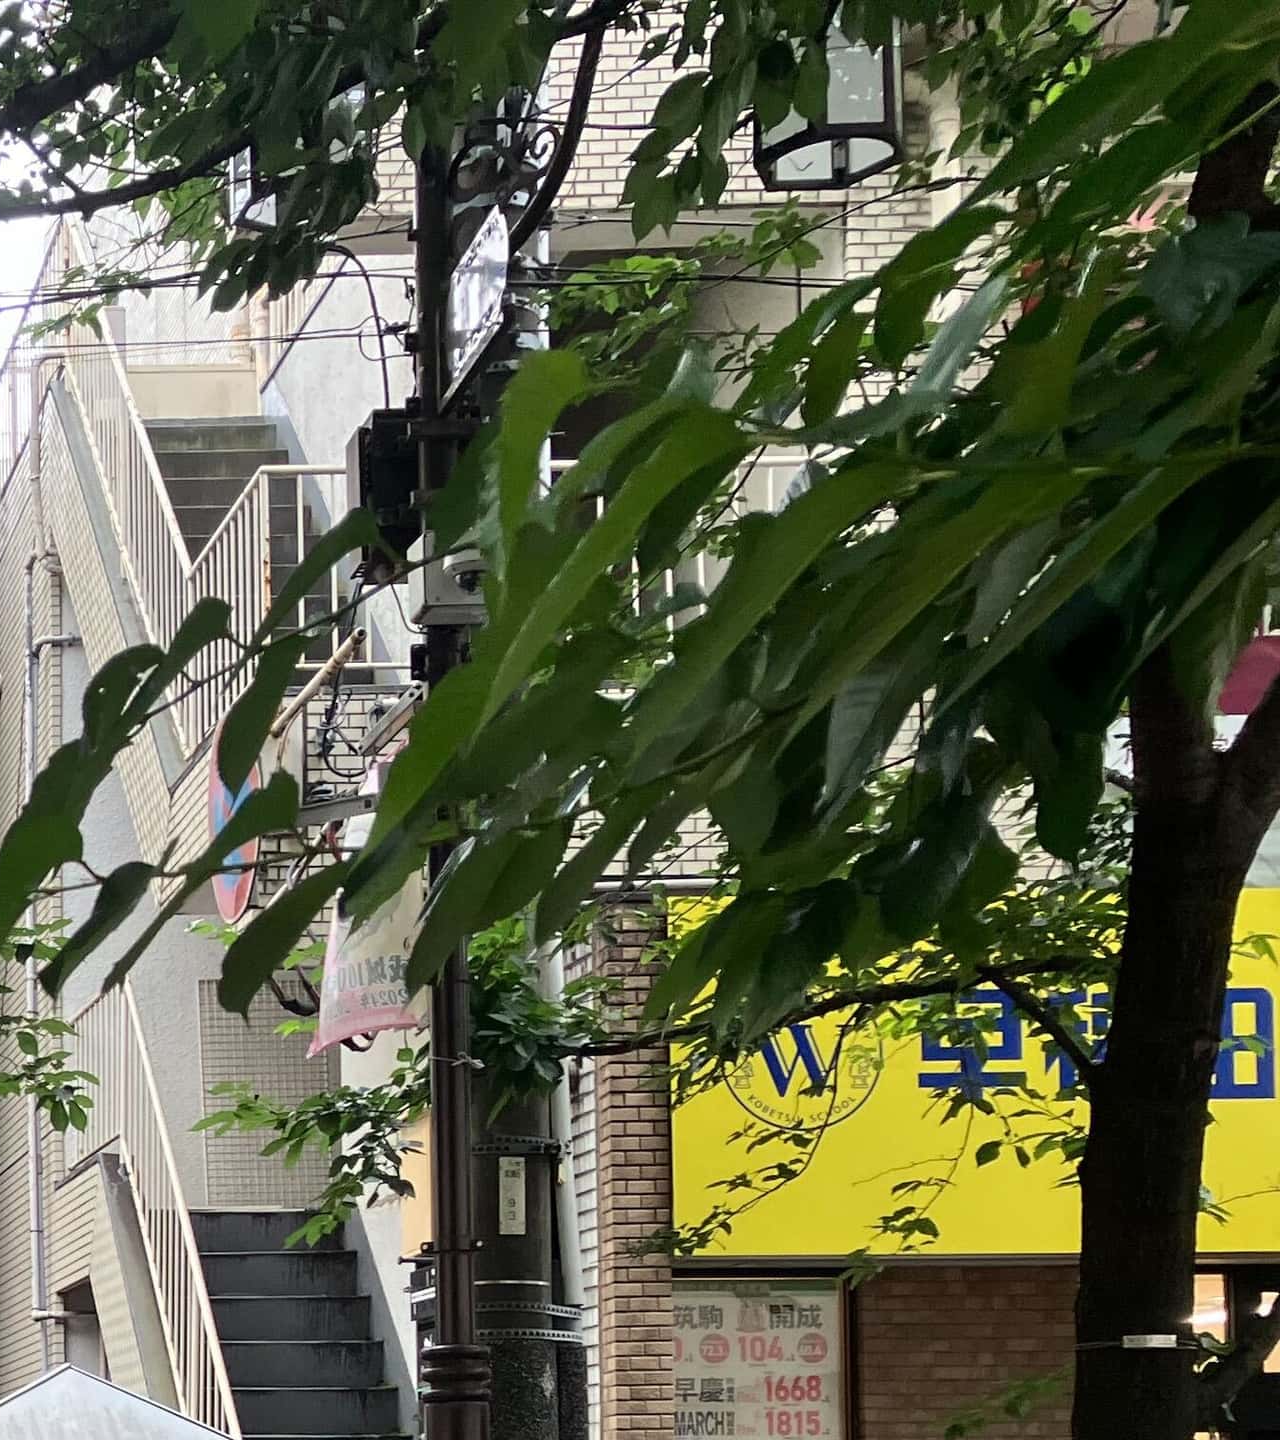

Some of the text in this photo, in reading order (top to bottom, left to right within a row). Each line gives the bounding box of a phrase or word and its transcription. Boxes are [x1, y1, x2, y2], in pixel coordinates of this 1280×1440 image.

[768, 1304, 823, 1330] 開成
[738, 1335, 784, 1362] 104
[674, 1377, 725, 1403] 早慶
[764, 1375, 822, 1402] 1668
[674, 1410, 726, 1437] MARCH
[766, 1410, 822, 1437] 1815
